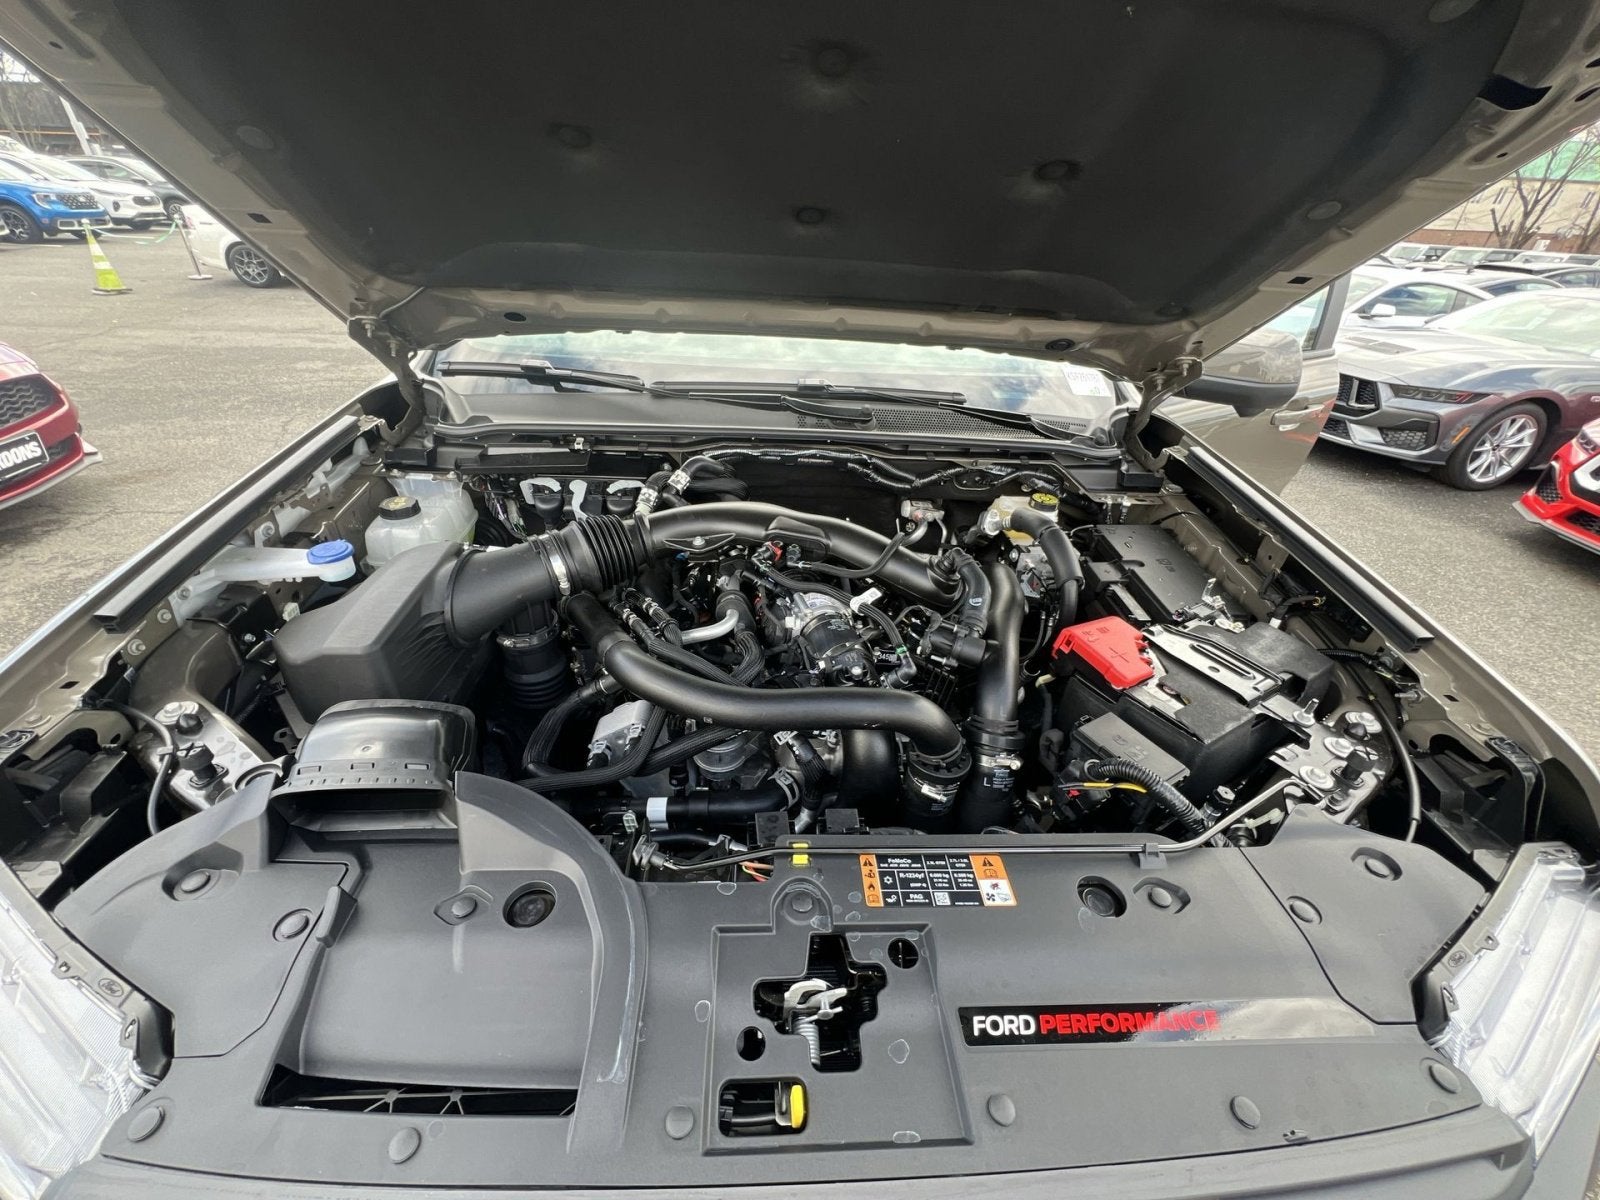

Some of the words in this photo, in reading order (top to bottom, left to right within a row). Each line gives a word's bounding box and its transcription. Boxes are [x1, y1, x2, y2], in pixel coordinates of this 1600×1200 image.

[0, 441, 42, 470] OONS
[973, 1014, 1036, 1036] FORD
[1039, 1010, 1219, 1034] PERFORMANCE
